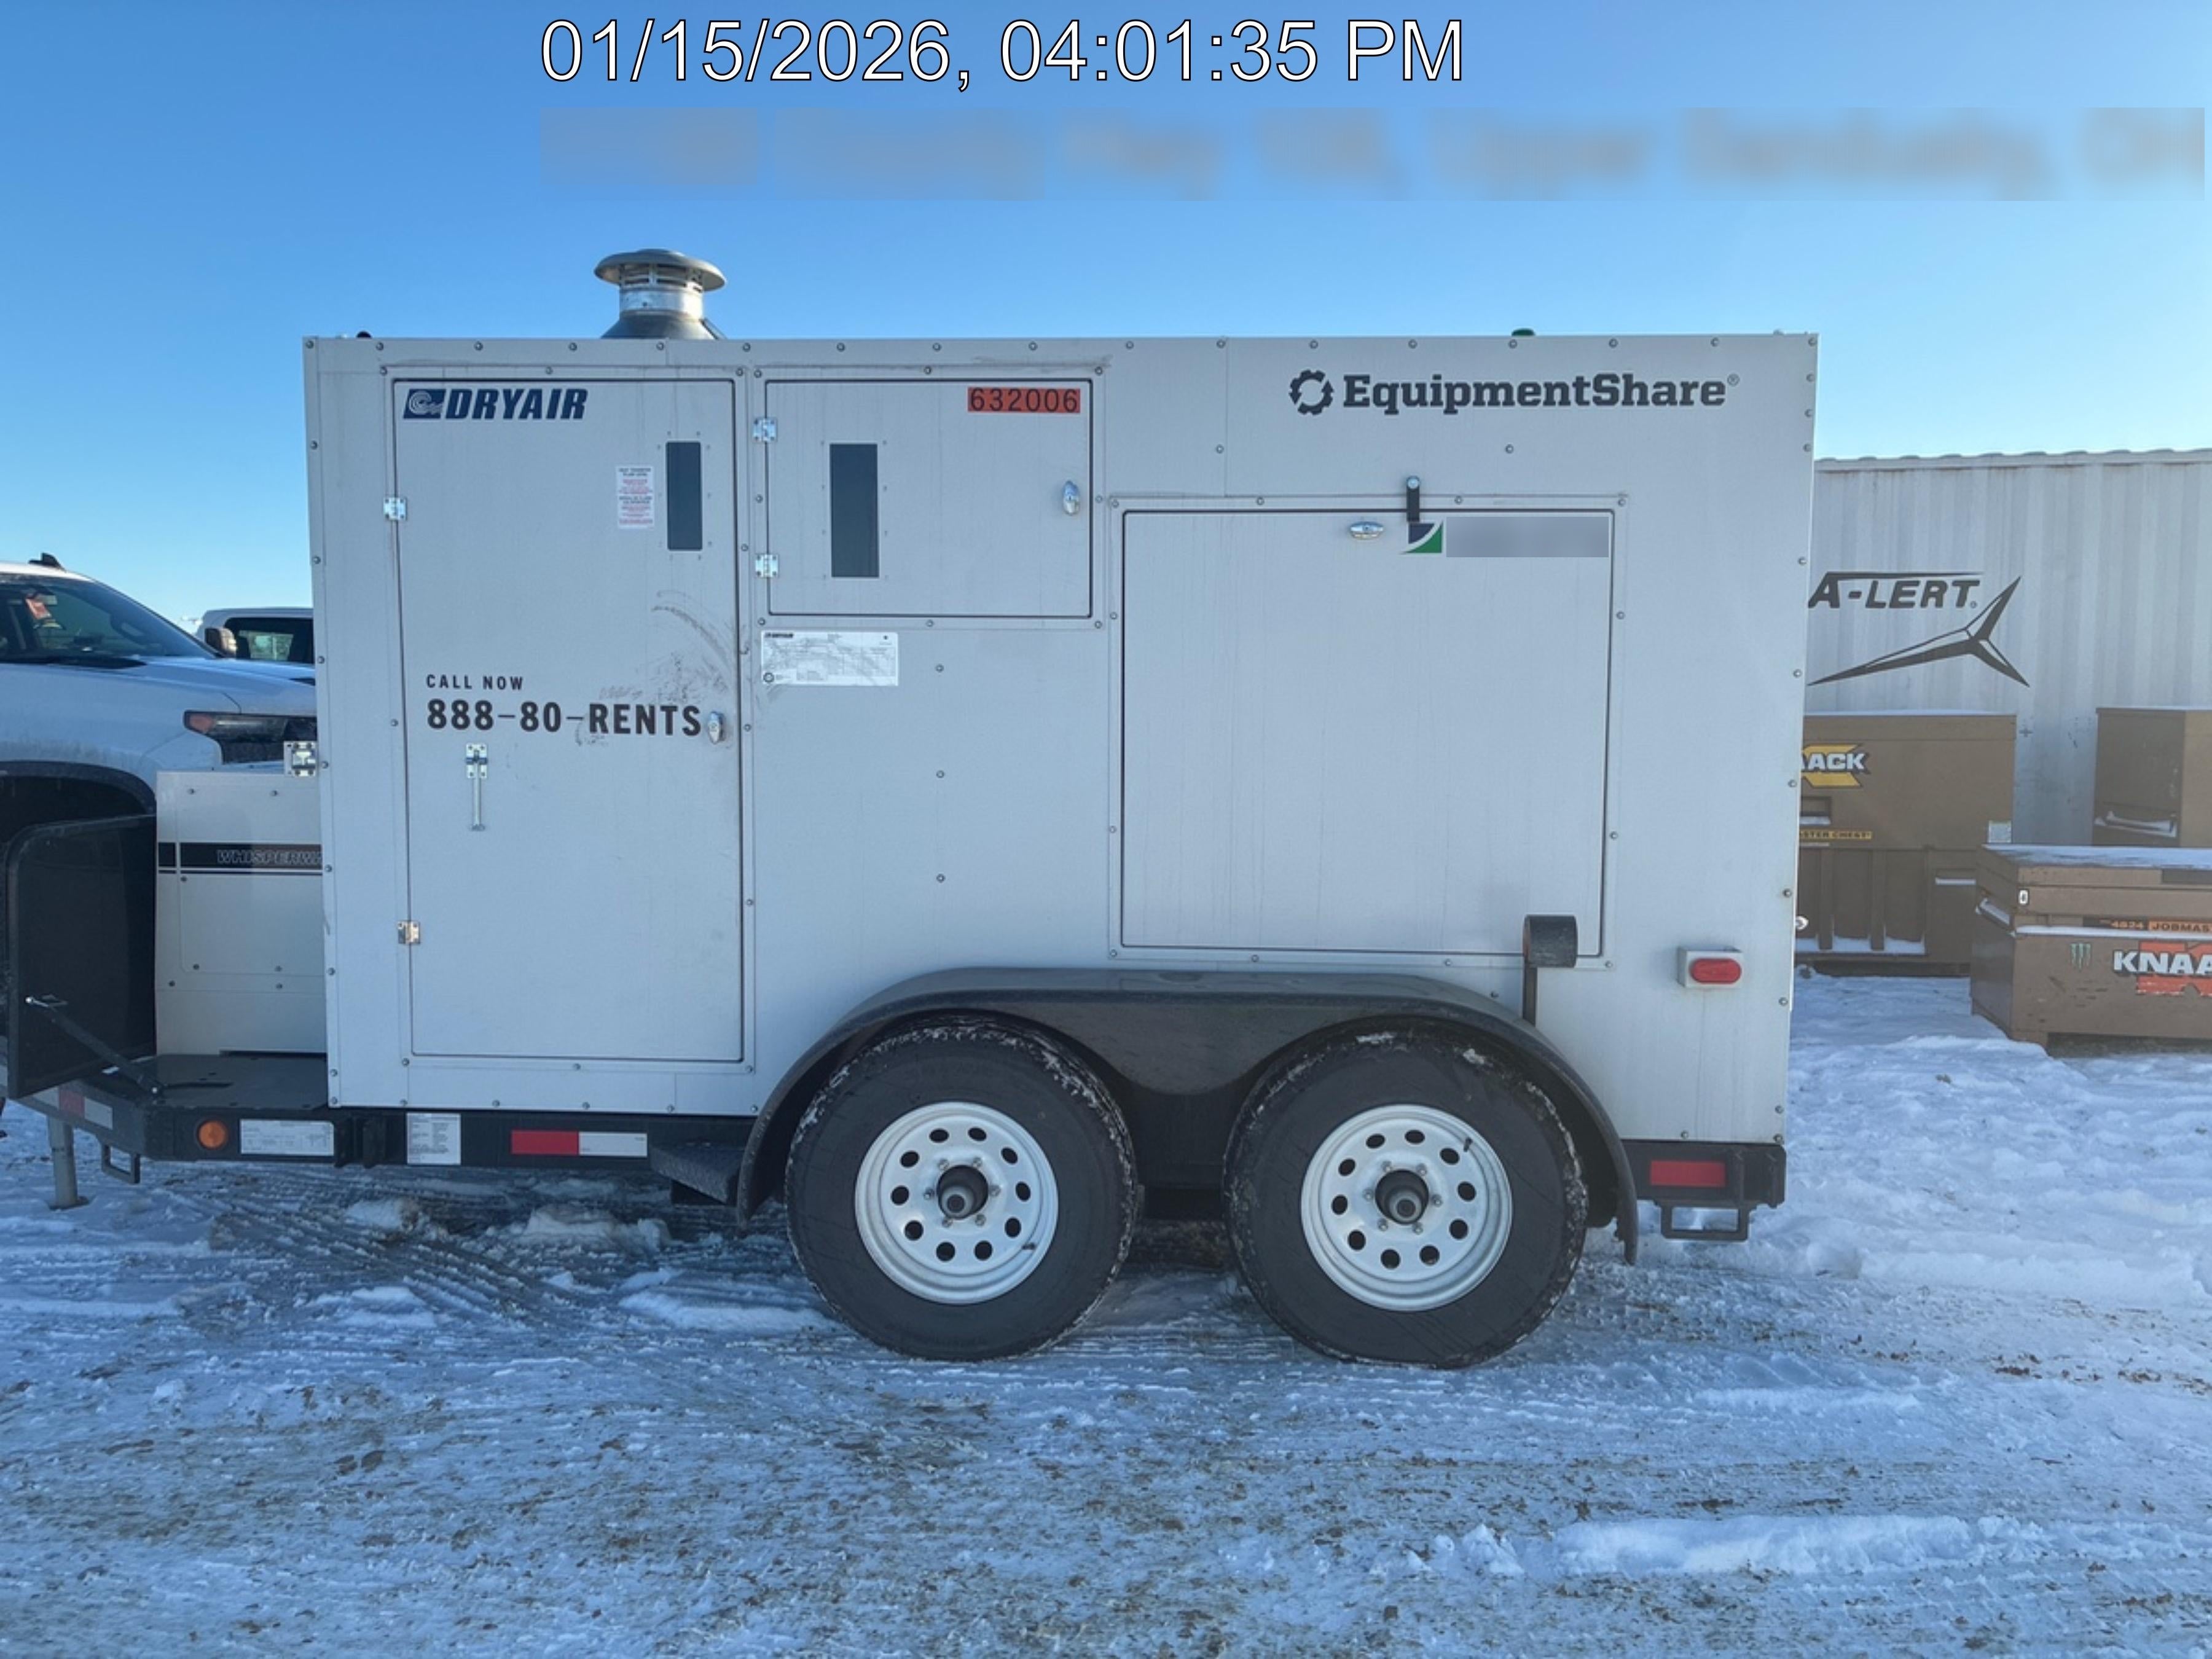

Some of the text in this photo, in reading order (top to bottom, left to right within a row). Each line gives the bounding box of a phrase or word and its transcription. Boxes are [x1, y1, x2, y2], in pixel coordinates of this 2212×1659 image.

[445, 388, 588, 420] DRYAIR
[971, 388, 1078, 413] 632006
[426, 675, 524, 690] CALL NOW
[427, 699, 701, 737] 888-80-RENTS
[1801, 752, 1867, 771] ACK
[2152, 923, 2212, 932] JOBMAS
